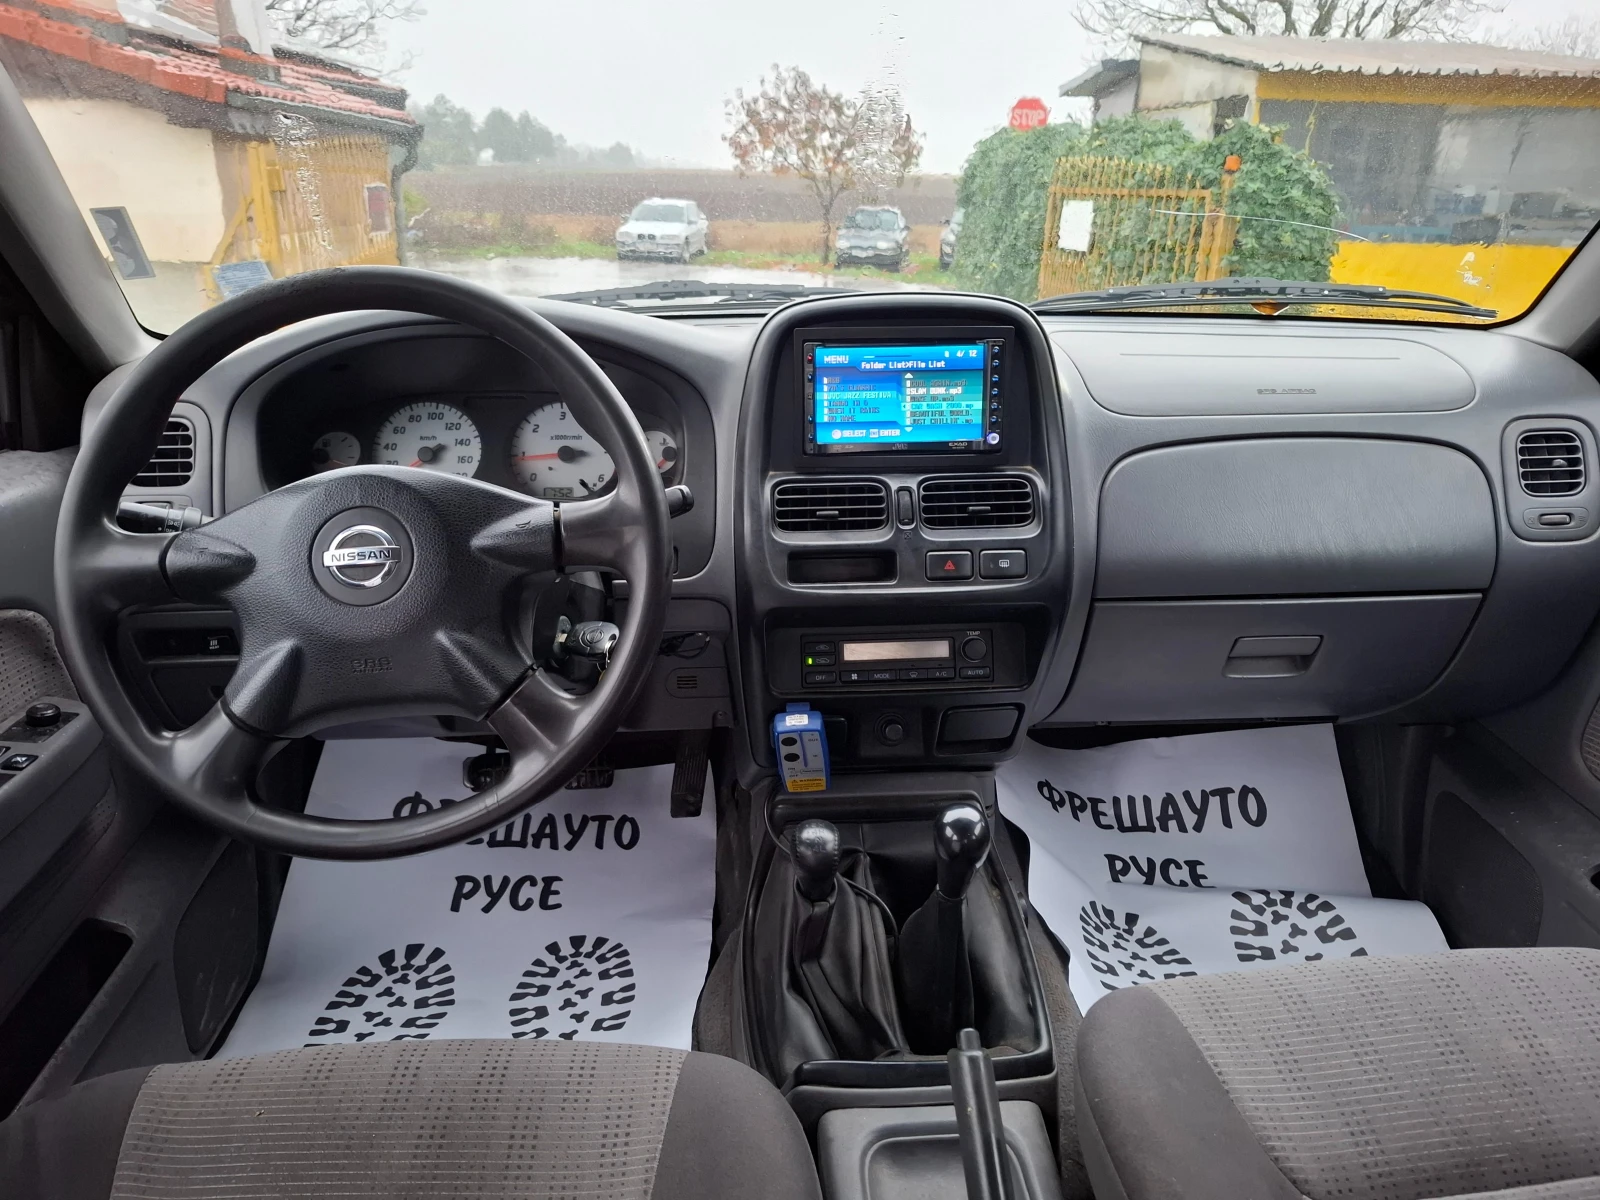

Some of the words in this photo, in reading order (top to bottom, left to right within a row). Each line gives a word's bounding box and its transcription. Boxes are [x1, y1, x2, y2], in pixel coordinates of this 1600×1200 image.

[1012, 109, 1045, 126] STOP
[824, 355, 849, 364] MENU
[861, 361, 886, 369] Folder
[928, 360, 946, 368] List
[910, 387, 926, 395] SLAM
[408, 415, 422, 423] 80
[427, 412, 444, 420] 100
[559, 411, 566, 420] 3
[445, 423, 462, 431] 120
[532, 424, 540, 433] 2
[842, 429, 867, 438] SELECT
[880, 428, 900, 437] ENTER
[383, 443, 398, 451] 40
[455, 439, 471, 447] 140
[457, 456, 474, 464] 160
[529, 473, 537, 482] 0
[598, 474, 605, 483] 6
[332, 549, 392, 562] NISSAN
[1037, 779, 1268, 834] ФРЕШАУТО
[1103, 853, 1218, 888] РУСЕ
[450, 874, 564, 914] РУСЕ
